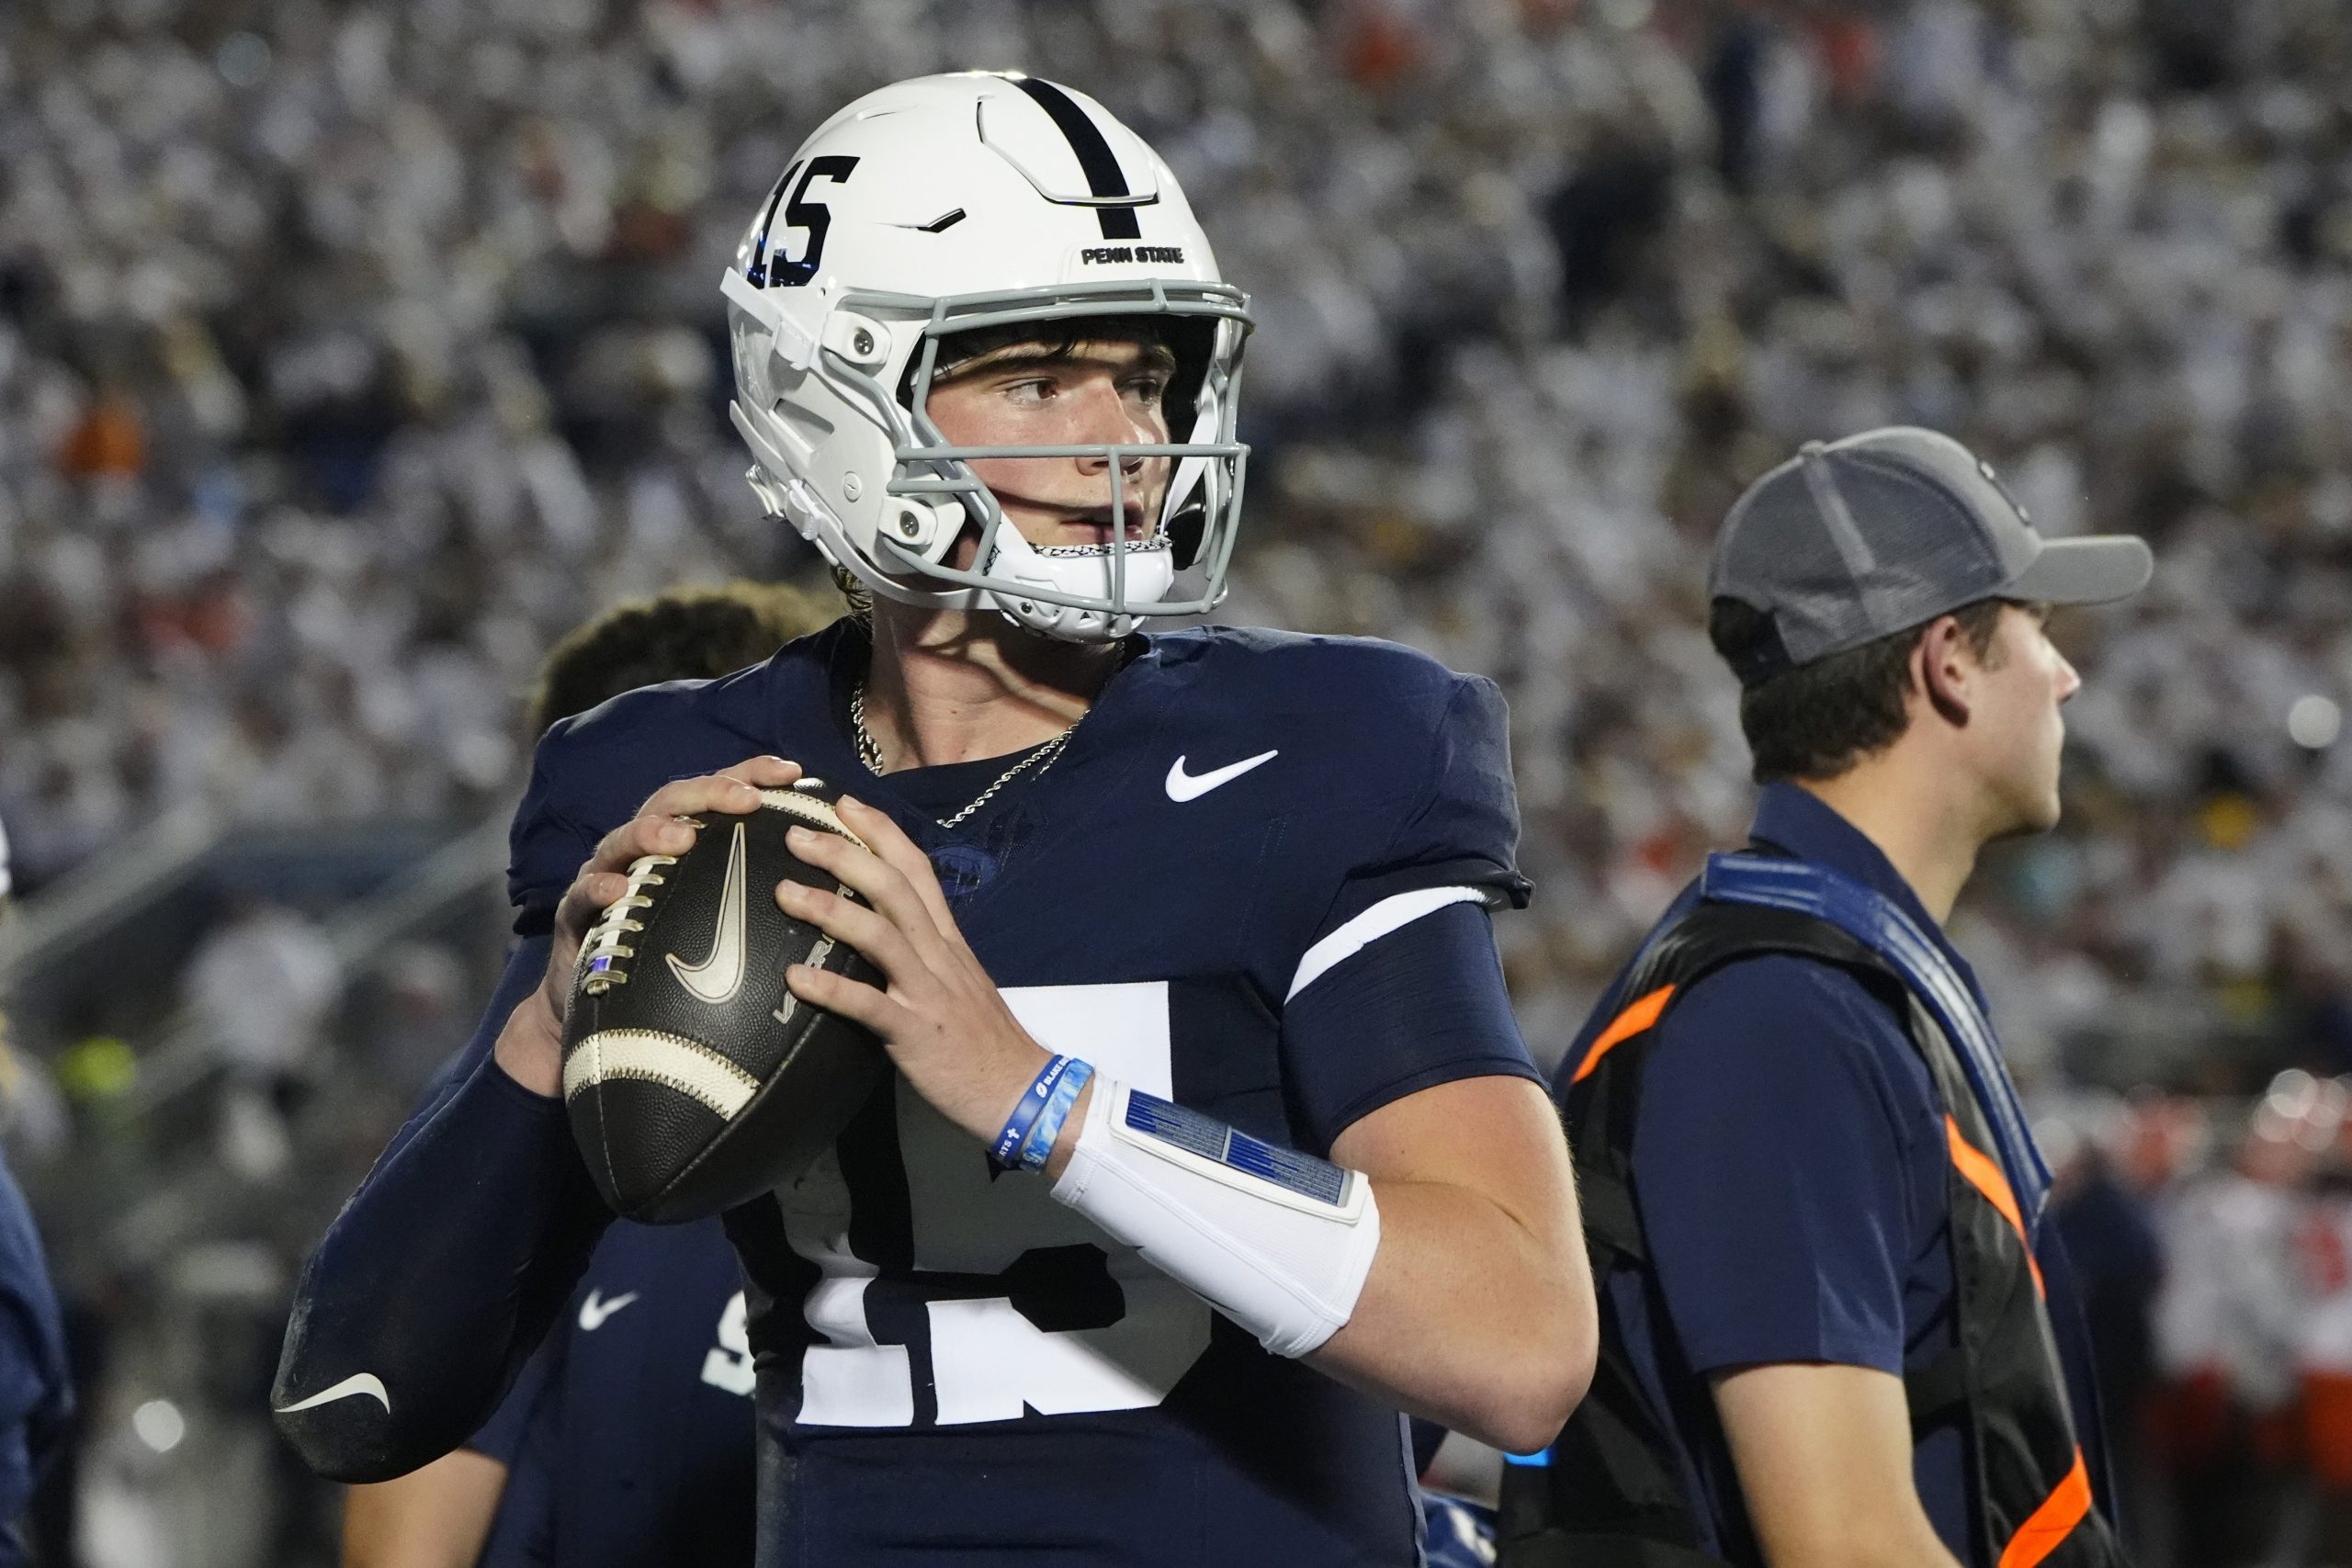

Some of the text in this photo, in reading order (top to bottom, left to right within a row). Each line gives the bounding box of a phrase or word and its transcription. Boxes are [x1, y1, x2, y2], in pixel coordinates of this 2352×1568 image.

[746, 155, 861, 290] 15
[1081, 246, 1184, 265] PENN STATE
[1043, 1063, 1063, 1086] BLAKE
